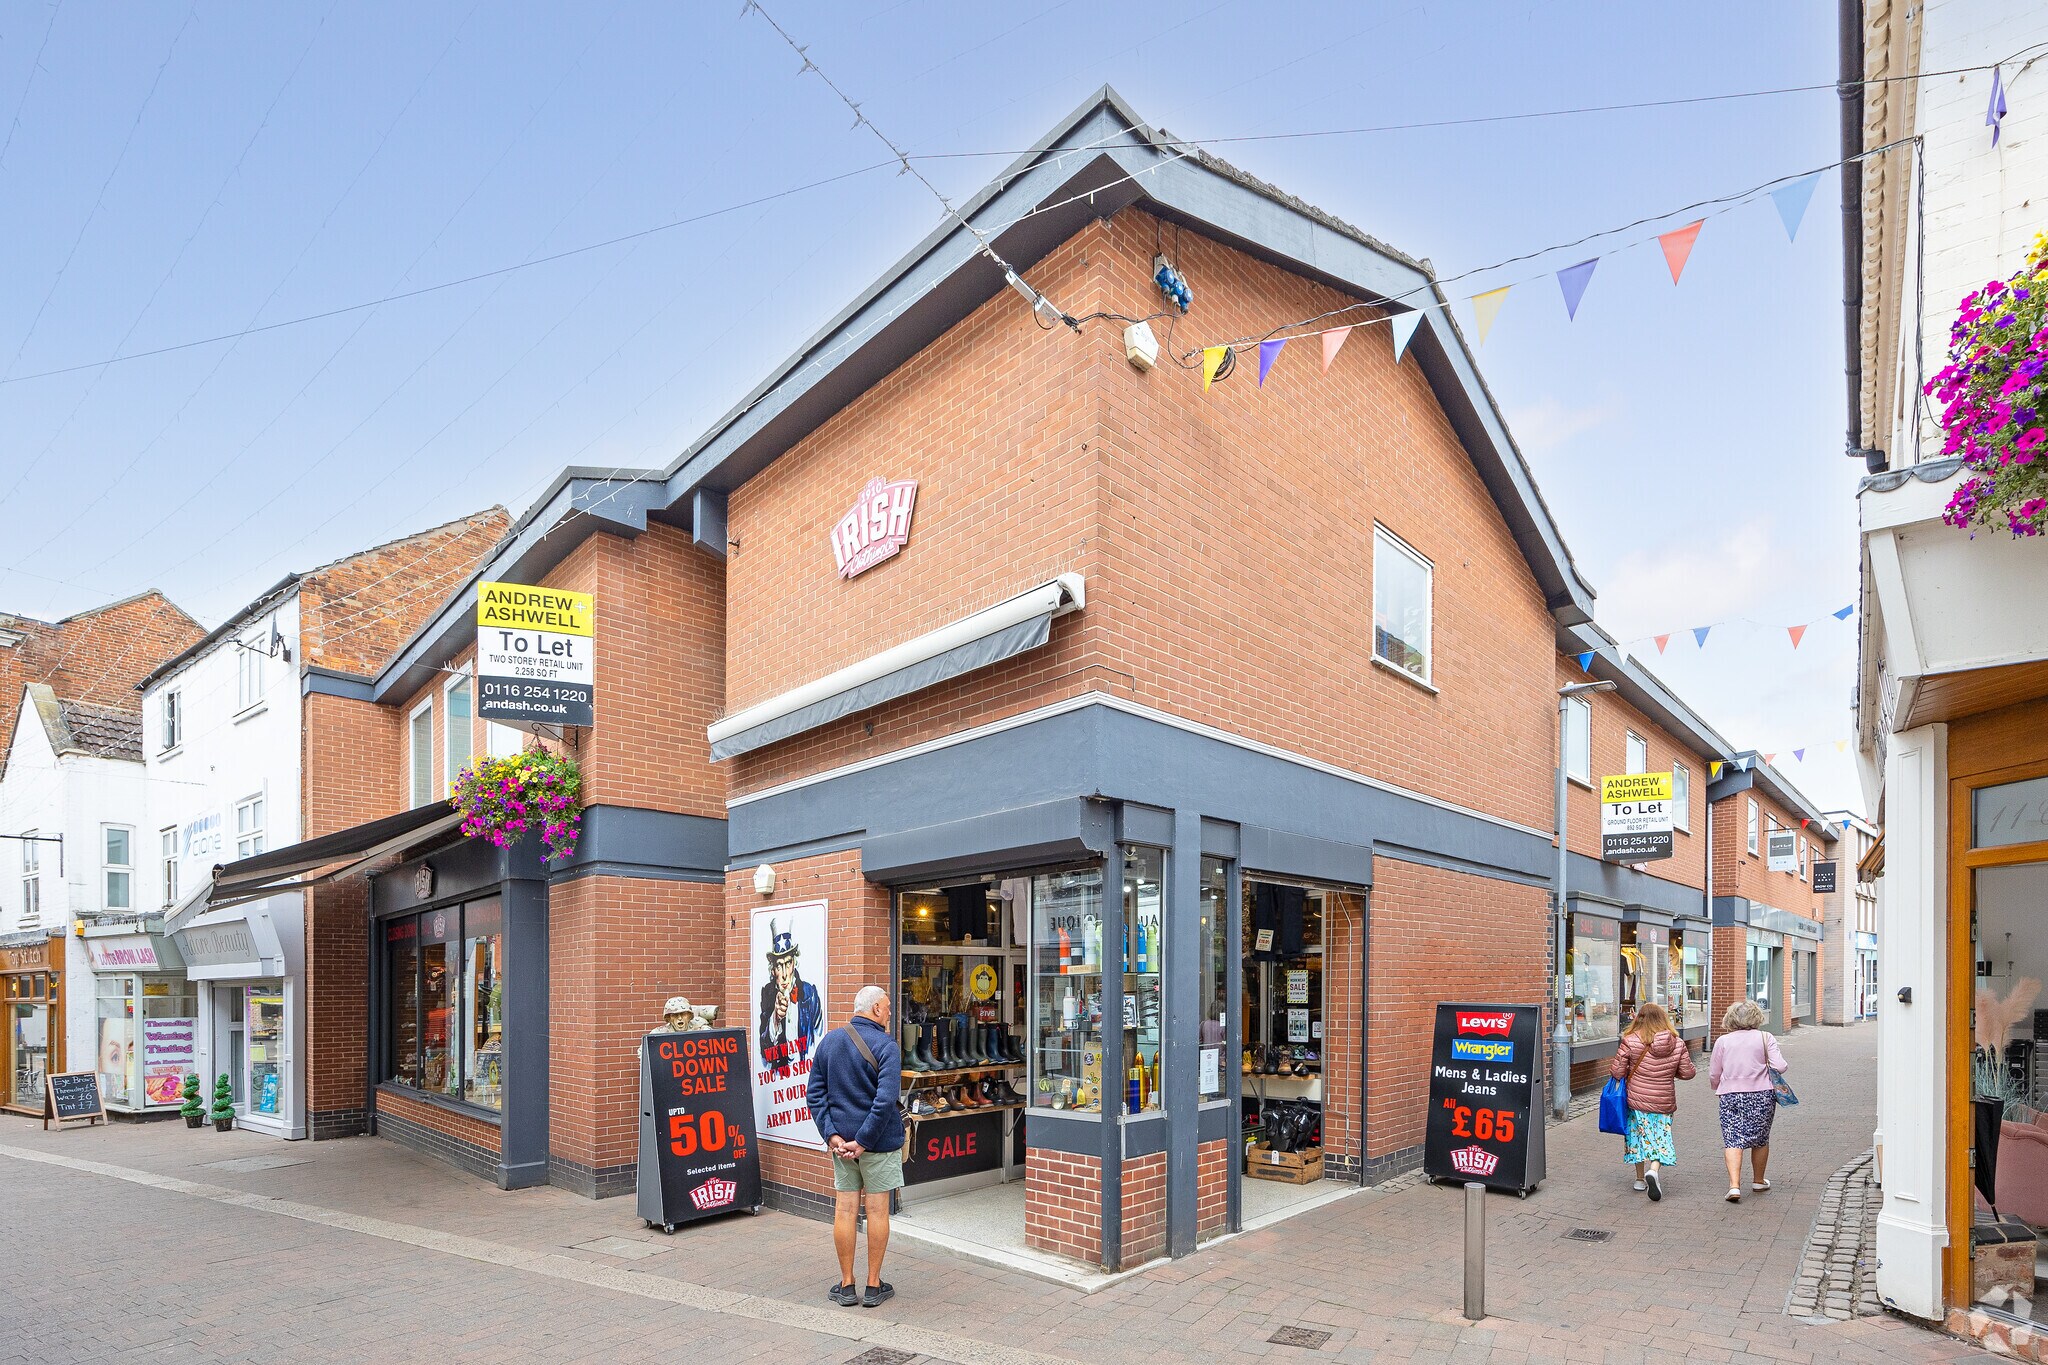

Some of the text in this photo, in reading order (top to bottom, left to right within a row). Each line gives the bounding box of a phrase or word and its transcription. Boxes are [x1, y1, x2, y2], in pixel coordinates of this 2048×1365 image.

[831, 487, 914, 571] IRISH
[485, 590, 573, 610] ANDREW
[485, 607, 580, 628] ASHWELL
[499, 631, 573, 658] To Let
[489, 654, 584, 671] TWO STOREY RETAIL UNIT
[536, 669, 547, 677] SQ
[549, 670, 558, 679] FT
[484, 683, 587, 702] 0116 254 1220
[485, 700, 567, 714] andash.co.uk
[1607, 777, 1660, 789] ANDREW
[1607, 788, 1664, 799] ASHWELL
[1612, 802, 1662, 815] To Let
[1607, 835, 1669, 846] 0116 254 1220
[1606, 846, 1658, 855] andash.co.uk
[183, 930, 250, 957] Adore Beauty
[115, 949, 137, 965] BROW
[138, 947, 157, 964] LASH
[145, 1031, 193, 1041] Waxing
[145, 1044, 193, 1054] Tinting
[659, 1037, 738, 1060] CLOSING
[764, 1036, 808, 1062] WE WANT
[1455, 1041, 1512, 1060] Wrangler
[672, 1056, 729, 1078] DOWN
[758, 1058, 815, 1086] YOU TO SHO
[1435, 1066, 1527, 1084] Mens & Ladies
[54, 1078, 71, 1087] Eye
[84, 1083, 97, 1092] £5
[681, 1075, 727, 1096] SALE
[1461, 1082, 1497, 1096] Jeans
[78, 1092, 92, 1101] £6
[773, 1083, 807, 1105] IN OUR
[78, 1101, 95, 1110] £7
[668, 1107, 685, 1116] UPTO
[766, 1110, 792, 1129] ARMY
[1451, 1105, 1515, 1143] £65
[733, 1148, 747, 1159] OFF
[927, 1132, 977, 1161] SALE
[687, 1165, 717, 1176] Selected
[1451, 1151, 1498, 1172] IRISH
[690, 1183, 736, 1207] IRISH
